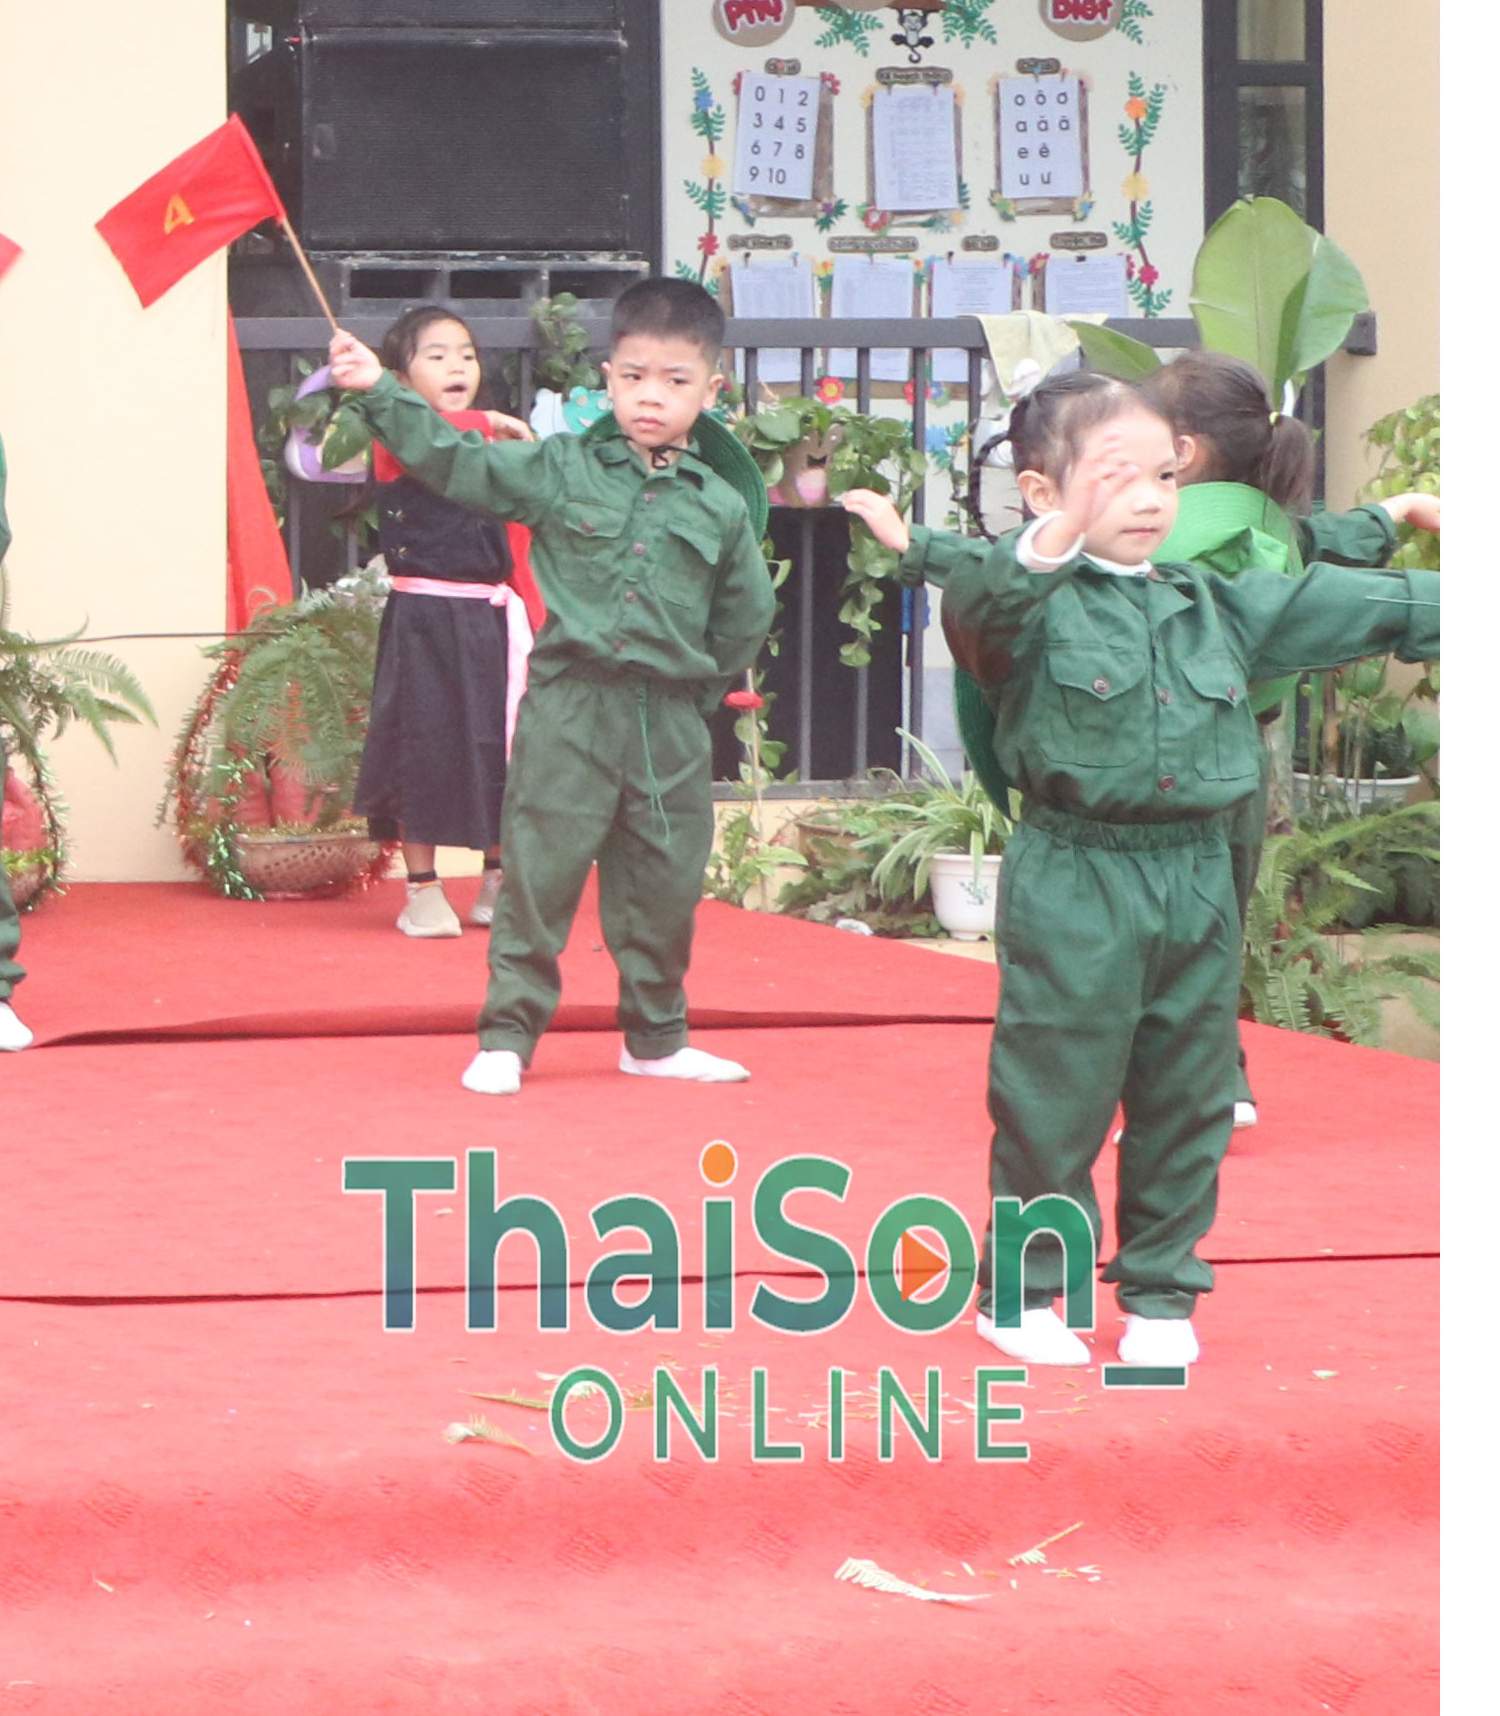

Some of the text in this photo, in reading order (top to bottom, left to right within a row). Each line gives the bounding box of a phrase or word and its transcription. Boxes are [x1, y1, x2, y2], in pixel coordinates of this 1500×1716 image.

[779, 88, 785, 103] 1
[797, 91, 808, 107] 2
[753, 113, 807, 133] 3 4 5
[1015, 120, 1027, 132] a
[750, 140, 805, 160] 6 7 8
[1017, 147, 1029, 159] e
[749, 165, 787, 185] 9 10
[1019, 173, 1030, 185] u
